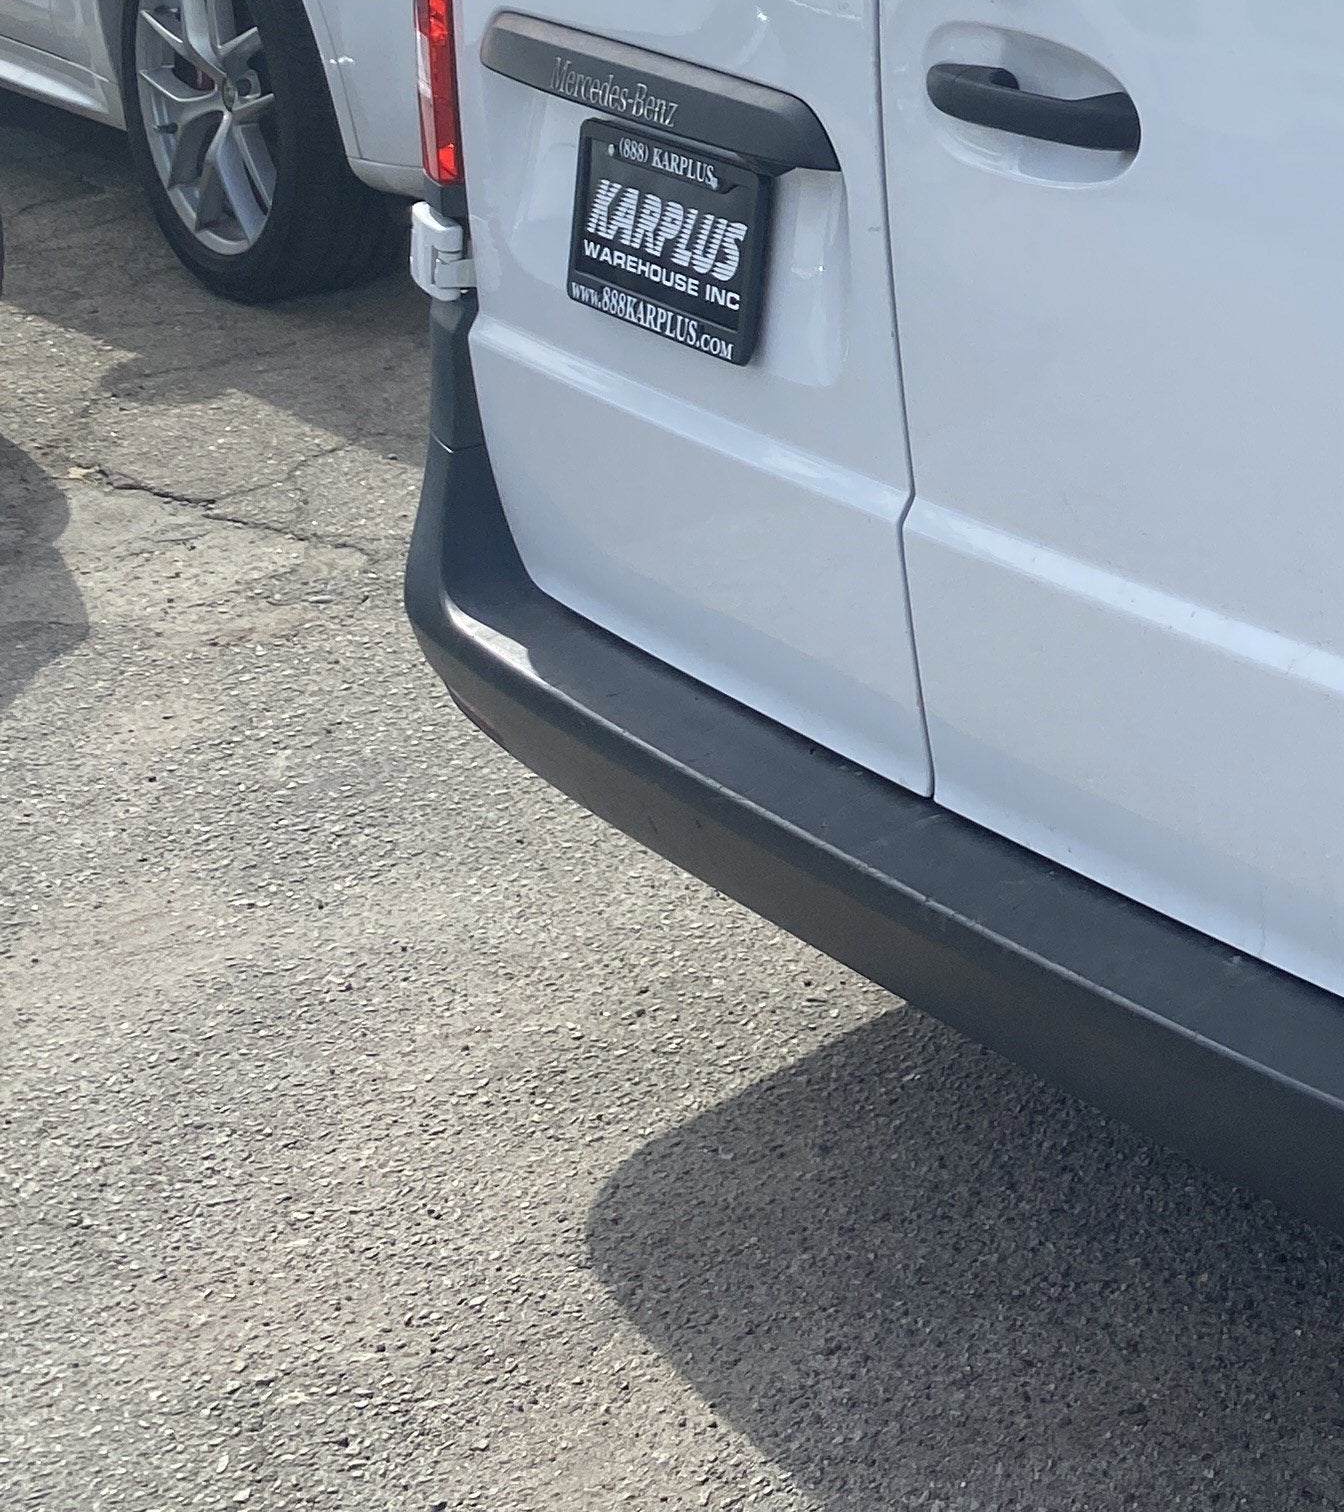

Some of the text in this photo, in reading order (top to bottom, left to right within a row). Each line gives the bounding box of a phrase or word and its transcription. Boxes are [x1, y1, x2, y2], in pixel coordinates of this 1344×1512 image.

[551, 57, 679, 127] Mercedes-Benz
[618, 138, 716, 185] (888) KARPLUS
[586, 179, 748, 282] KARPLUS
[584, 239, 740, 311] WAREHOUSE INC
